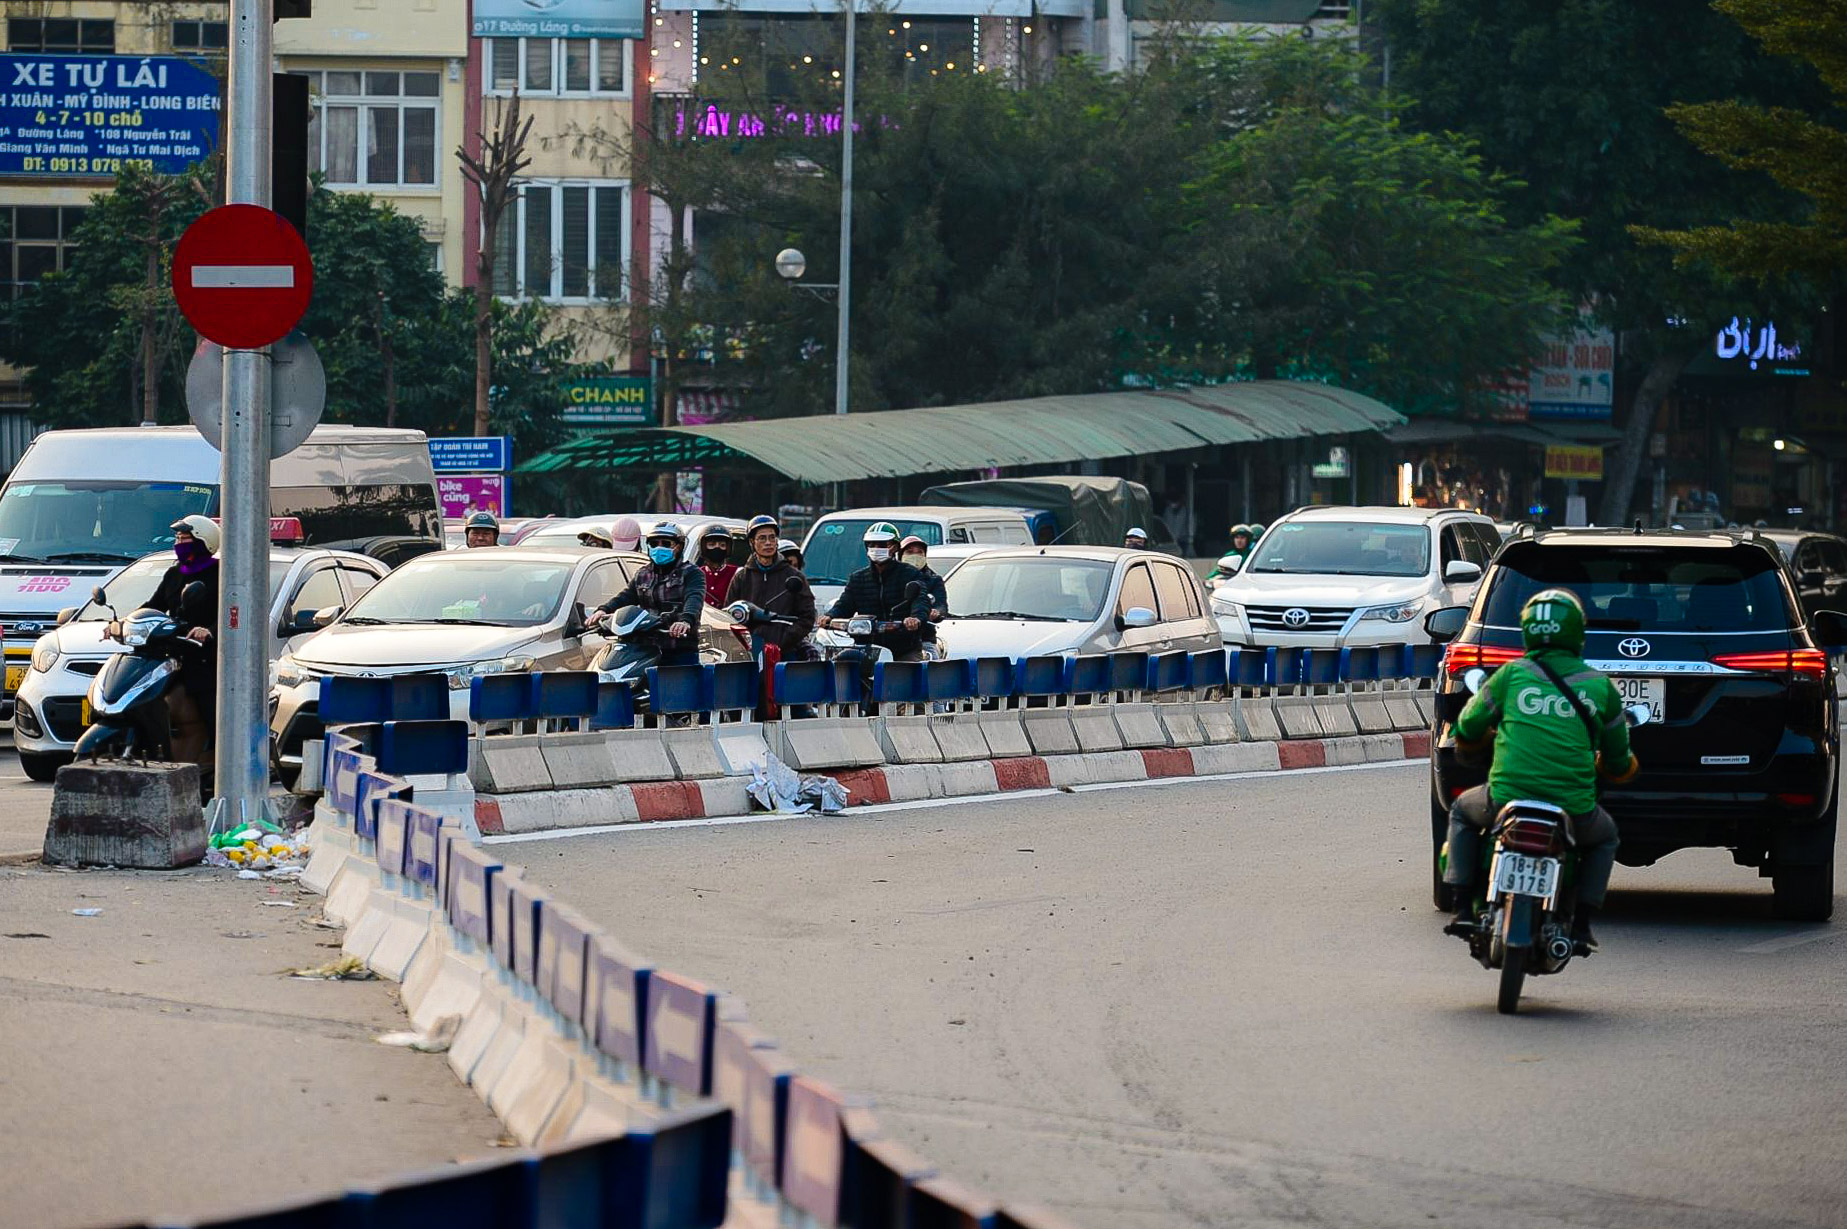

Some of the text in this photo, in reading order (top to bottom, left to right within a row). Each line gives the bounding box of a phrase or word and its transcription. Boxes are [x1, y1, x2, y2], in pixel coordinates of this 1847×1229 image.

[12, 58, 168, 94] XE TỰ LÁI
[11, 91, 54, 108] XUÂN
[140, 95, 182, 111] LONG
[50, 157, 89, 172] 0913
[570, 386, 646, 404] CHANH
[440, 480, 463, 492] bike
[18, 621, 36, 632] Ford
[1528, 619, 1561, 635] Grab
[1599, 663, 1706, 671] RTUNER
[1617, 679, 1651, 699] 30E
[1516, 686, 1598, 718] Grab
